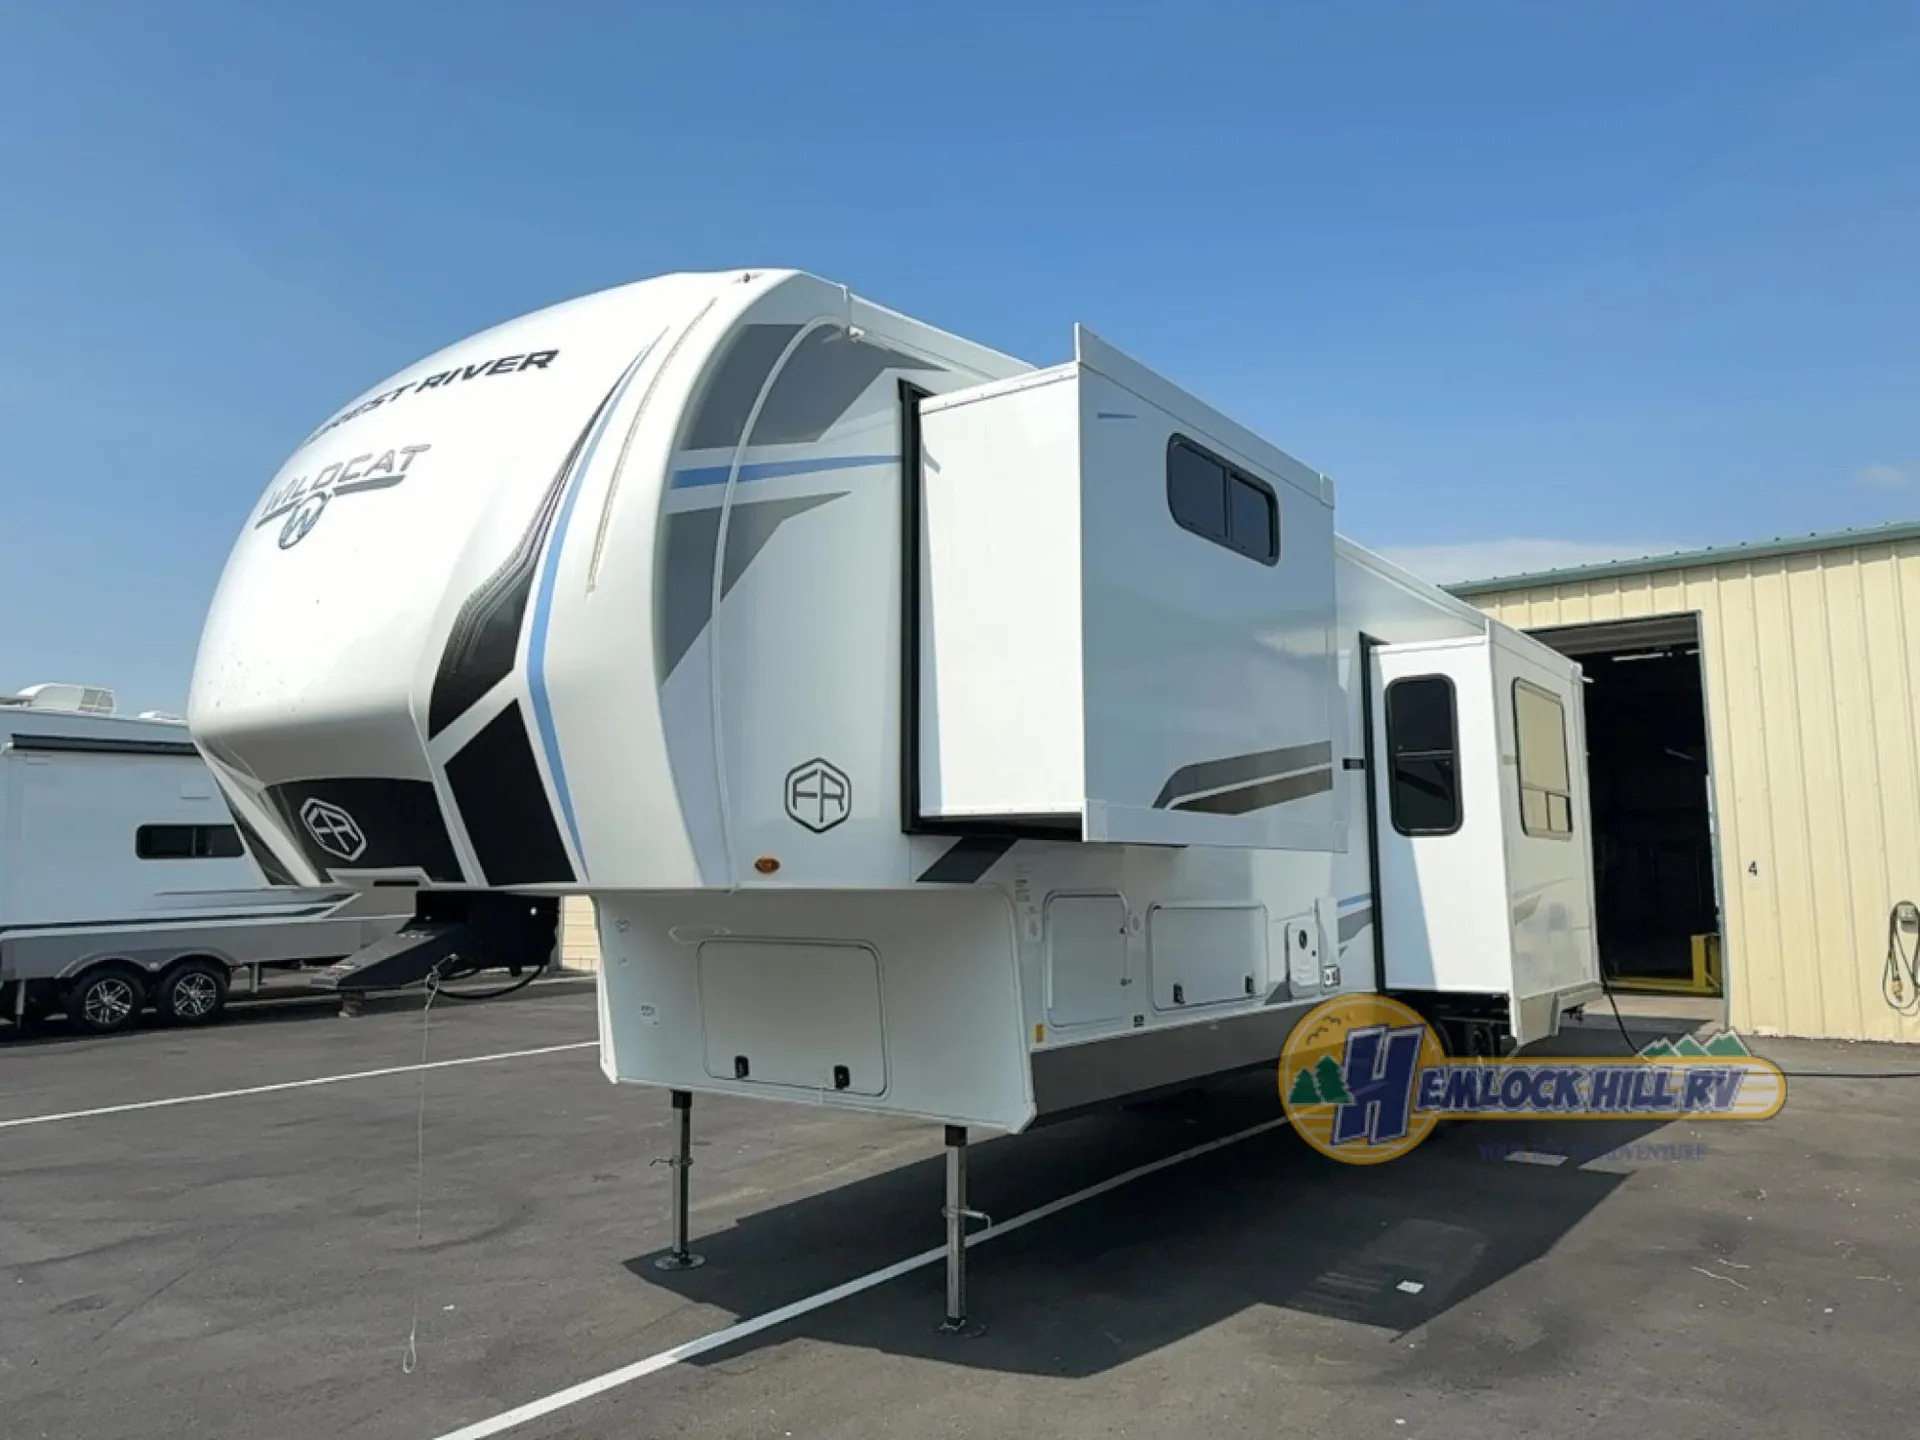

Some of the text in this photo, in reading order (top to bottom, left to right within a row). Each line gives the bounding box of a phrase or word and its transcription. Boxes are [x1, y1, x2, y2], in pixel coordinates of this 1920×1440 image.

[414, 349, 560, 393] RIVER
[261, 443, 432, 517] WILDCAT
[1747, 860, 1759, 877] 4
